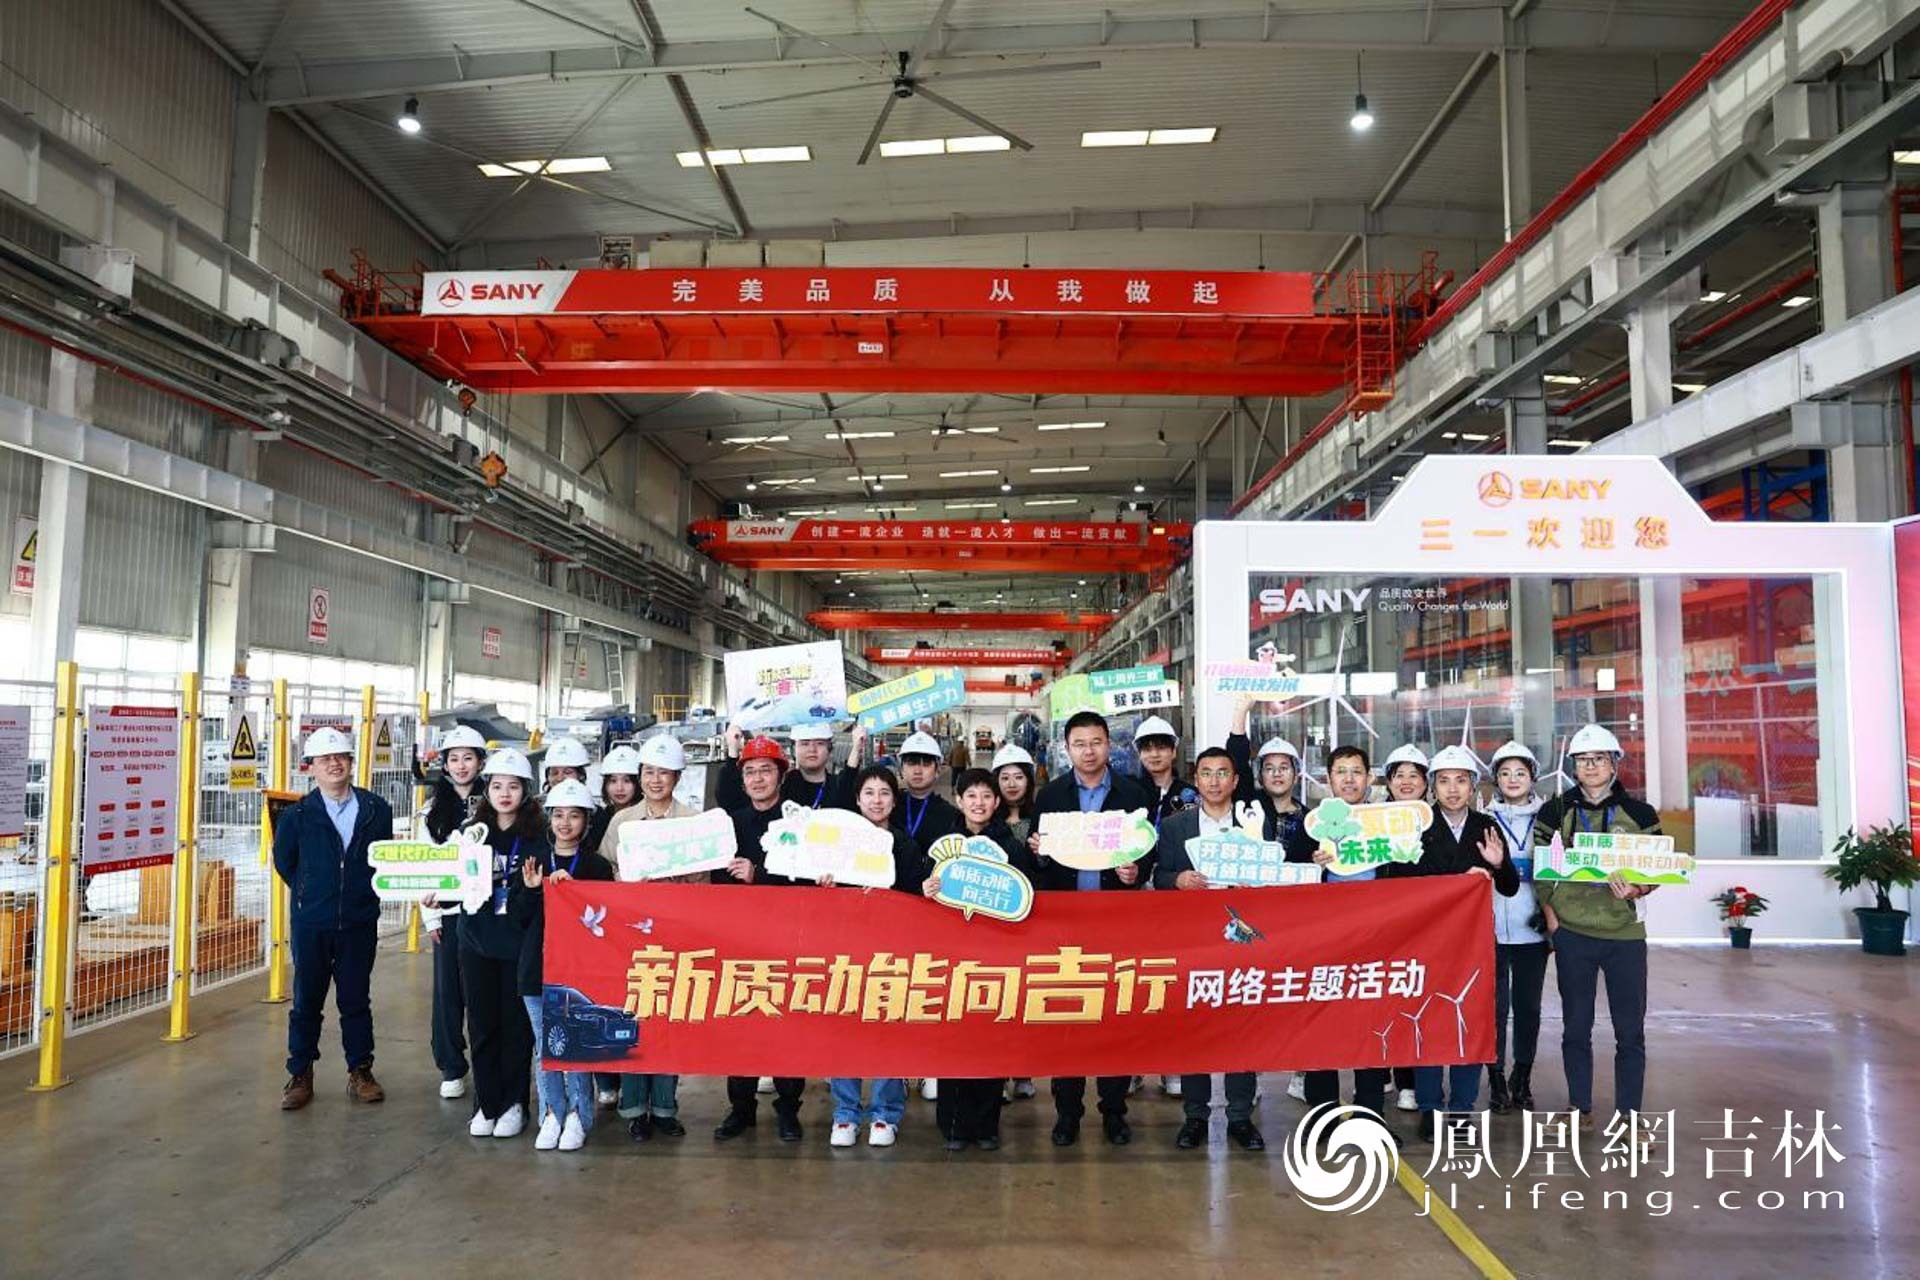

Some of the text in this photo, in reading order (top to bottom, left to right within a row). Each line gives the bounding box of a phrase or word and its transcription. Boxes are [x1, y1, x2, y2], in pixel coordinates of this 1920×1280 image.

[470, 283, 544, 301] SANY
[671, 279, 1220, 305] 完美品质 从我做起
[1519, 478, 1612, 500] SANY
[749, 526, 785, 536] SANY
[811, 525, 1128, 541] 创建一流企业 造就一流人才 做出一流贡献
[1420, 516, 1670, 550] 三一欢迎您
[1259, 588, 1372, 613] SANY
[1378, 587, 1448, 599] 品质改变世界
[1378, 600, 1509, 612] Quality Changes the World
[1340, 837, 1393, 865] 未来
[950, 864, 1012, 892] 新质动能
[961, 886, 1012, 910] 向吉行
[624, 945, 1426, 1026] 新质动能向吉行 网络主题活动
